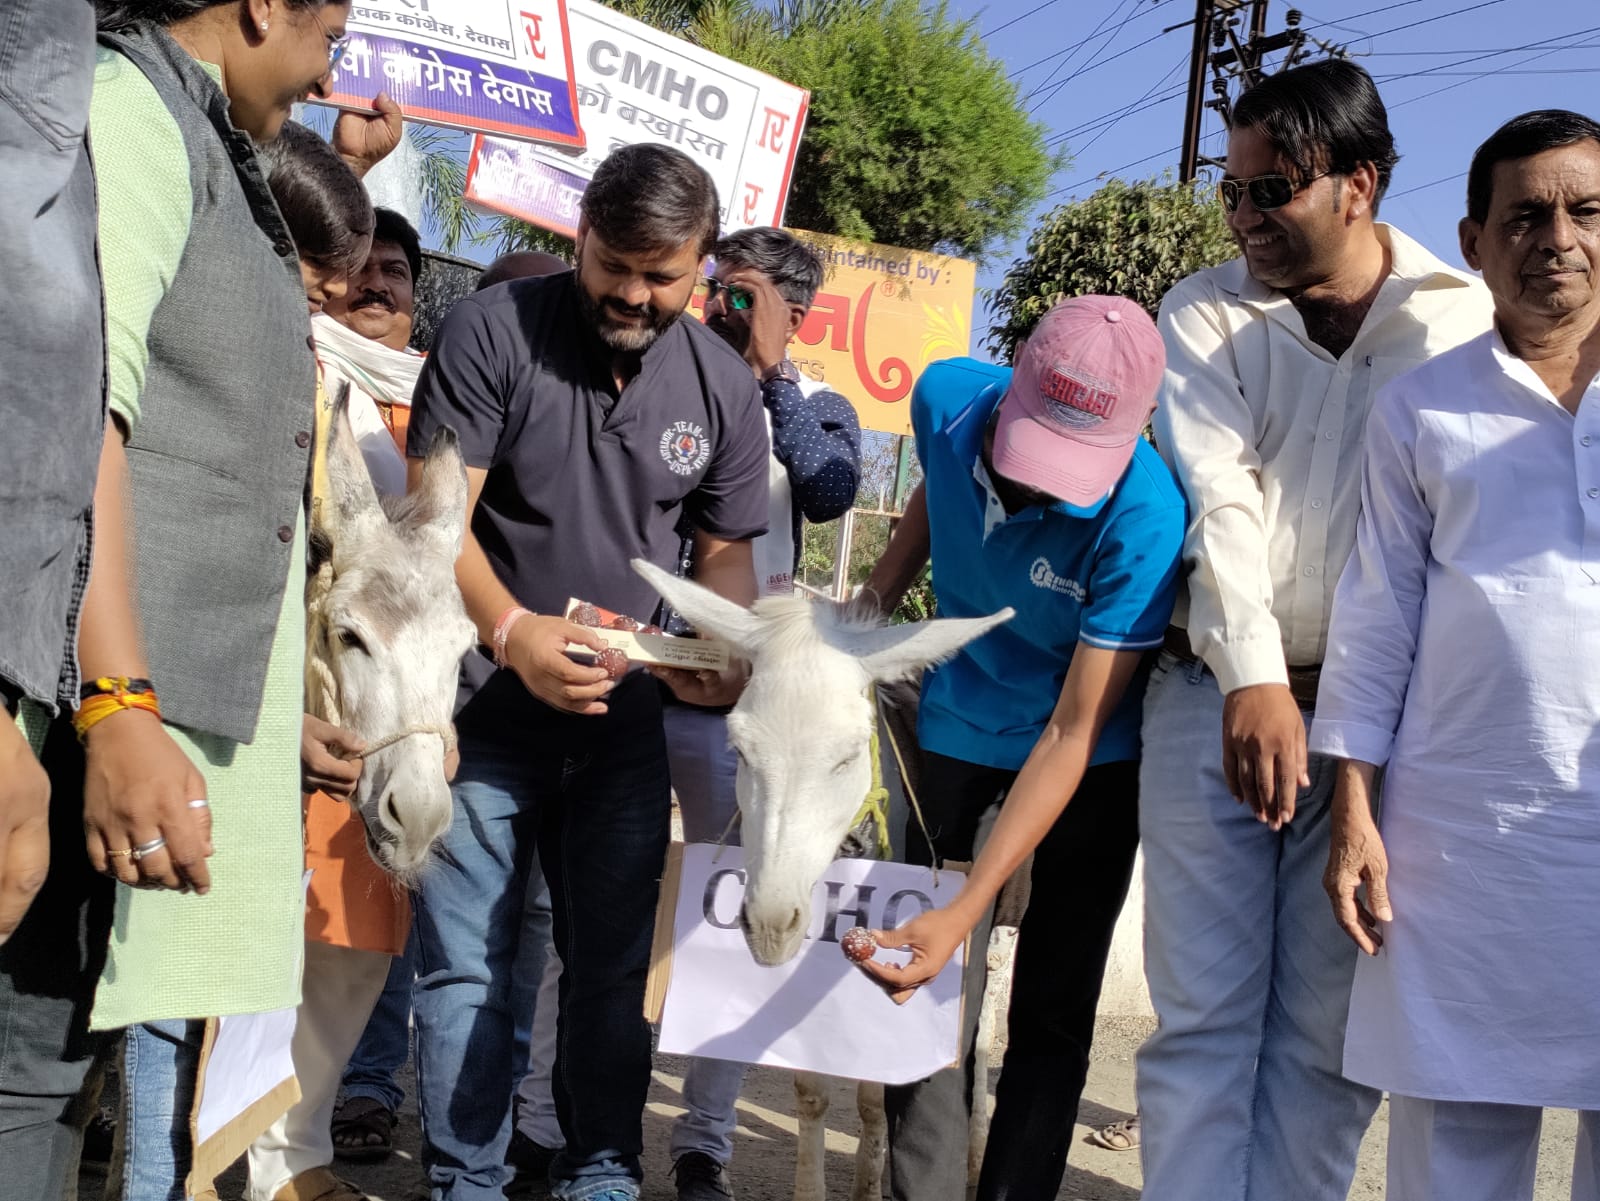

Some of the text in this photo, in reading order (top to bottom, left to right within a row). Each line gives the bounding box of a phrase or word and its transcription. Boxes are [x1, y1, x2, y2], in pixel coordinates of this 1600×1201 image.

[464, 24, 510, 51] देवास
[382, 47, 472, 97] कांग्रेस
[479, 63, 553, 116] देवास
[587, 39, 729, 121] CMHO
[804, 243, 911, 276] aintained
[916, 260, 941, 286] by
[673, 420, 703, 437] TEAM
